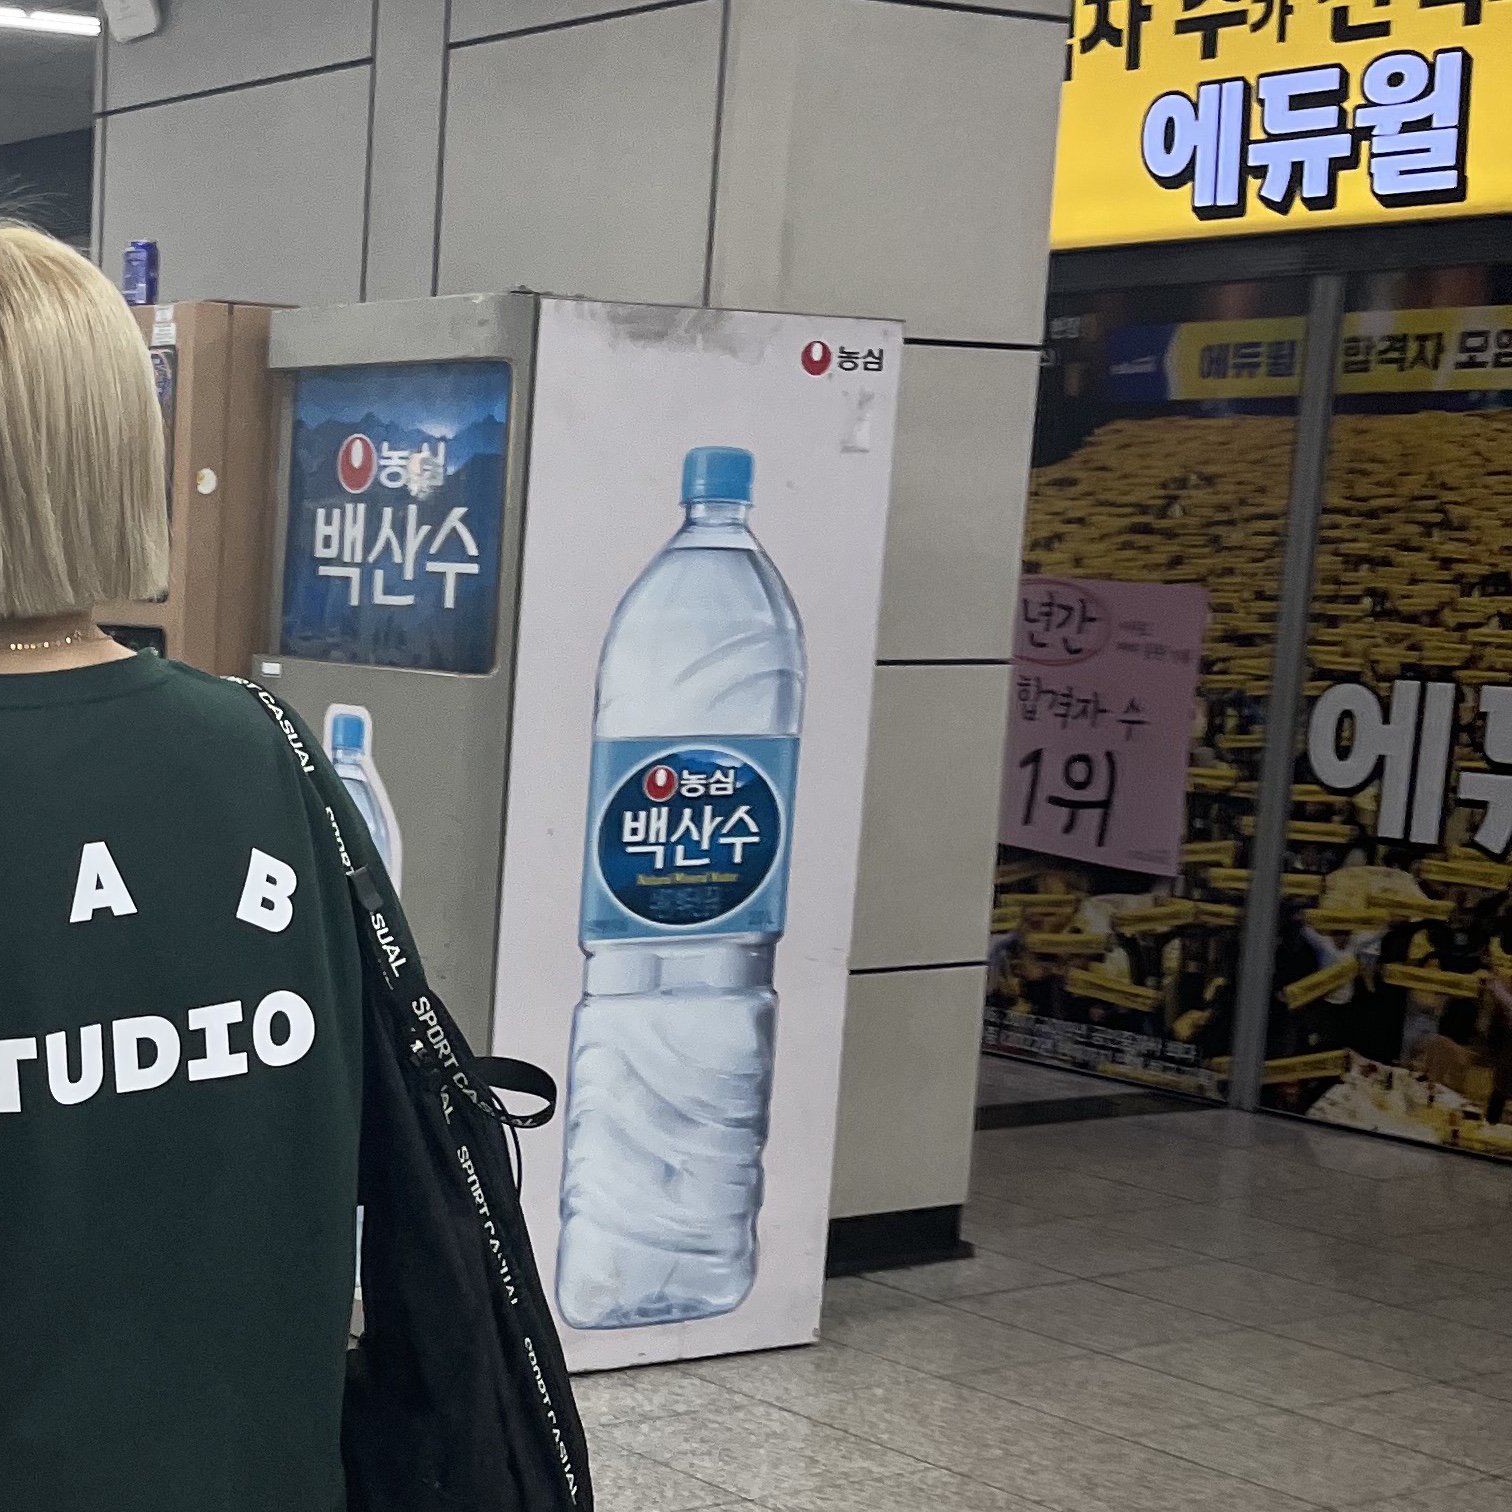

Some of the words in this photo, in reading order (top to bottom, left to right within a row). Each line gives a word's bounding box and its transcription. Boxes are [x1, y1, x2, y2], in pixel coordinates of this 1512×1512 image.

[1141, 47, 1472, 220] 에듀윌
[837, 346, 884, 372] 농심
[1200, 338, 1297, 380] 에듀윌
[1342, 331, 1445, 374] 합격자
[314, 502, 480, 609] 백산수
[1016, 674, 1110, 731] 합격자
[1116, 698, 1152, 741] 수
[679, 768, 735, 798] 농심
[1018, 748, 1117, 848] 1위
[622, 805, 761, 869] 백산수
[369, 912, 407, 978] SUAL
[411, 996, 459, 1068] SPORT
